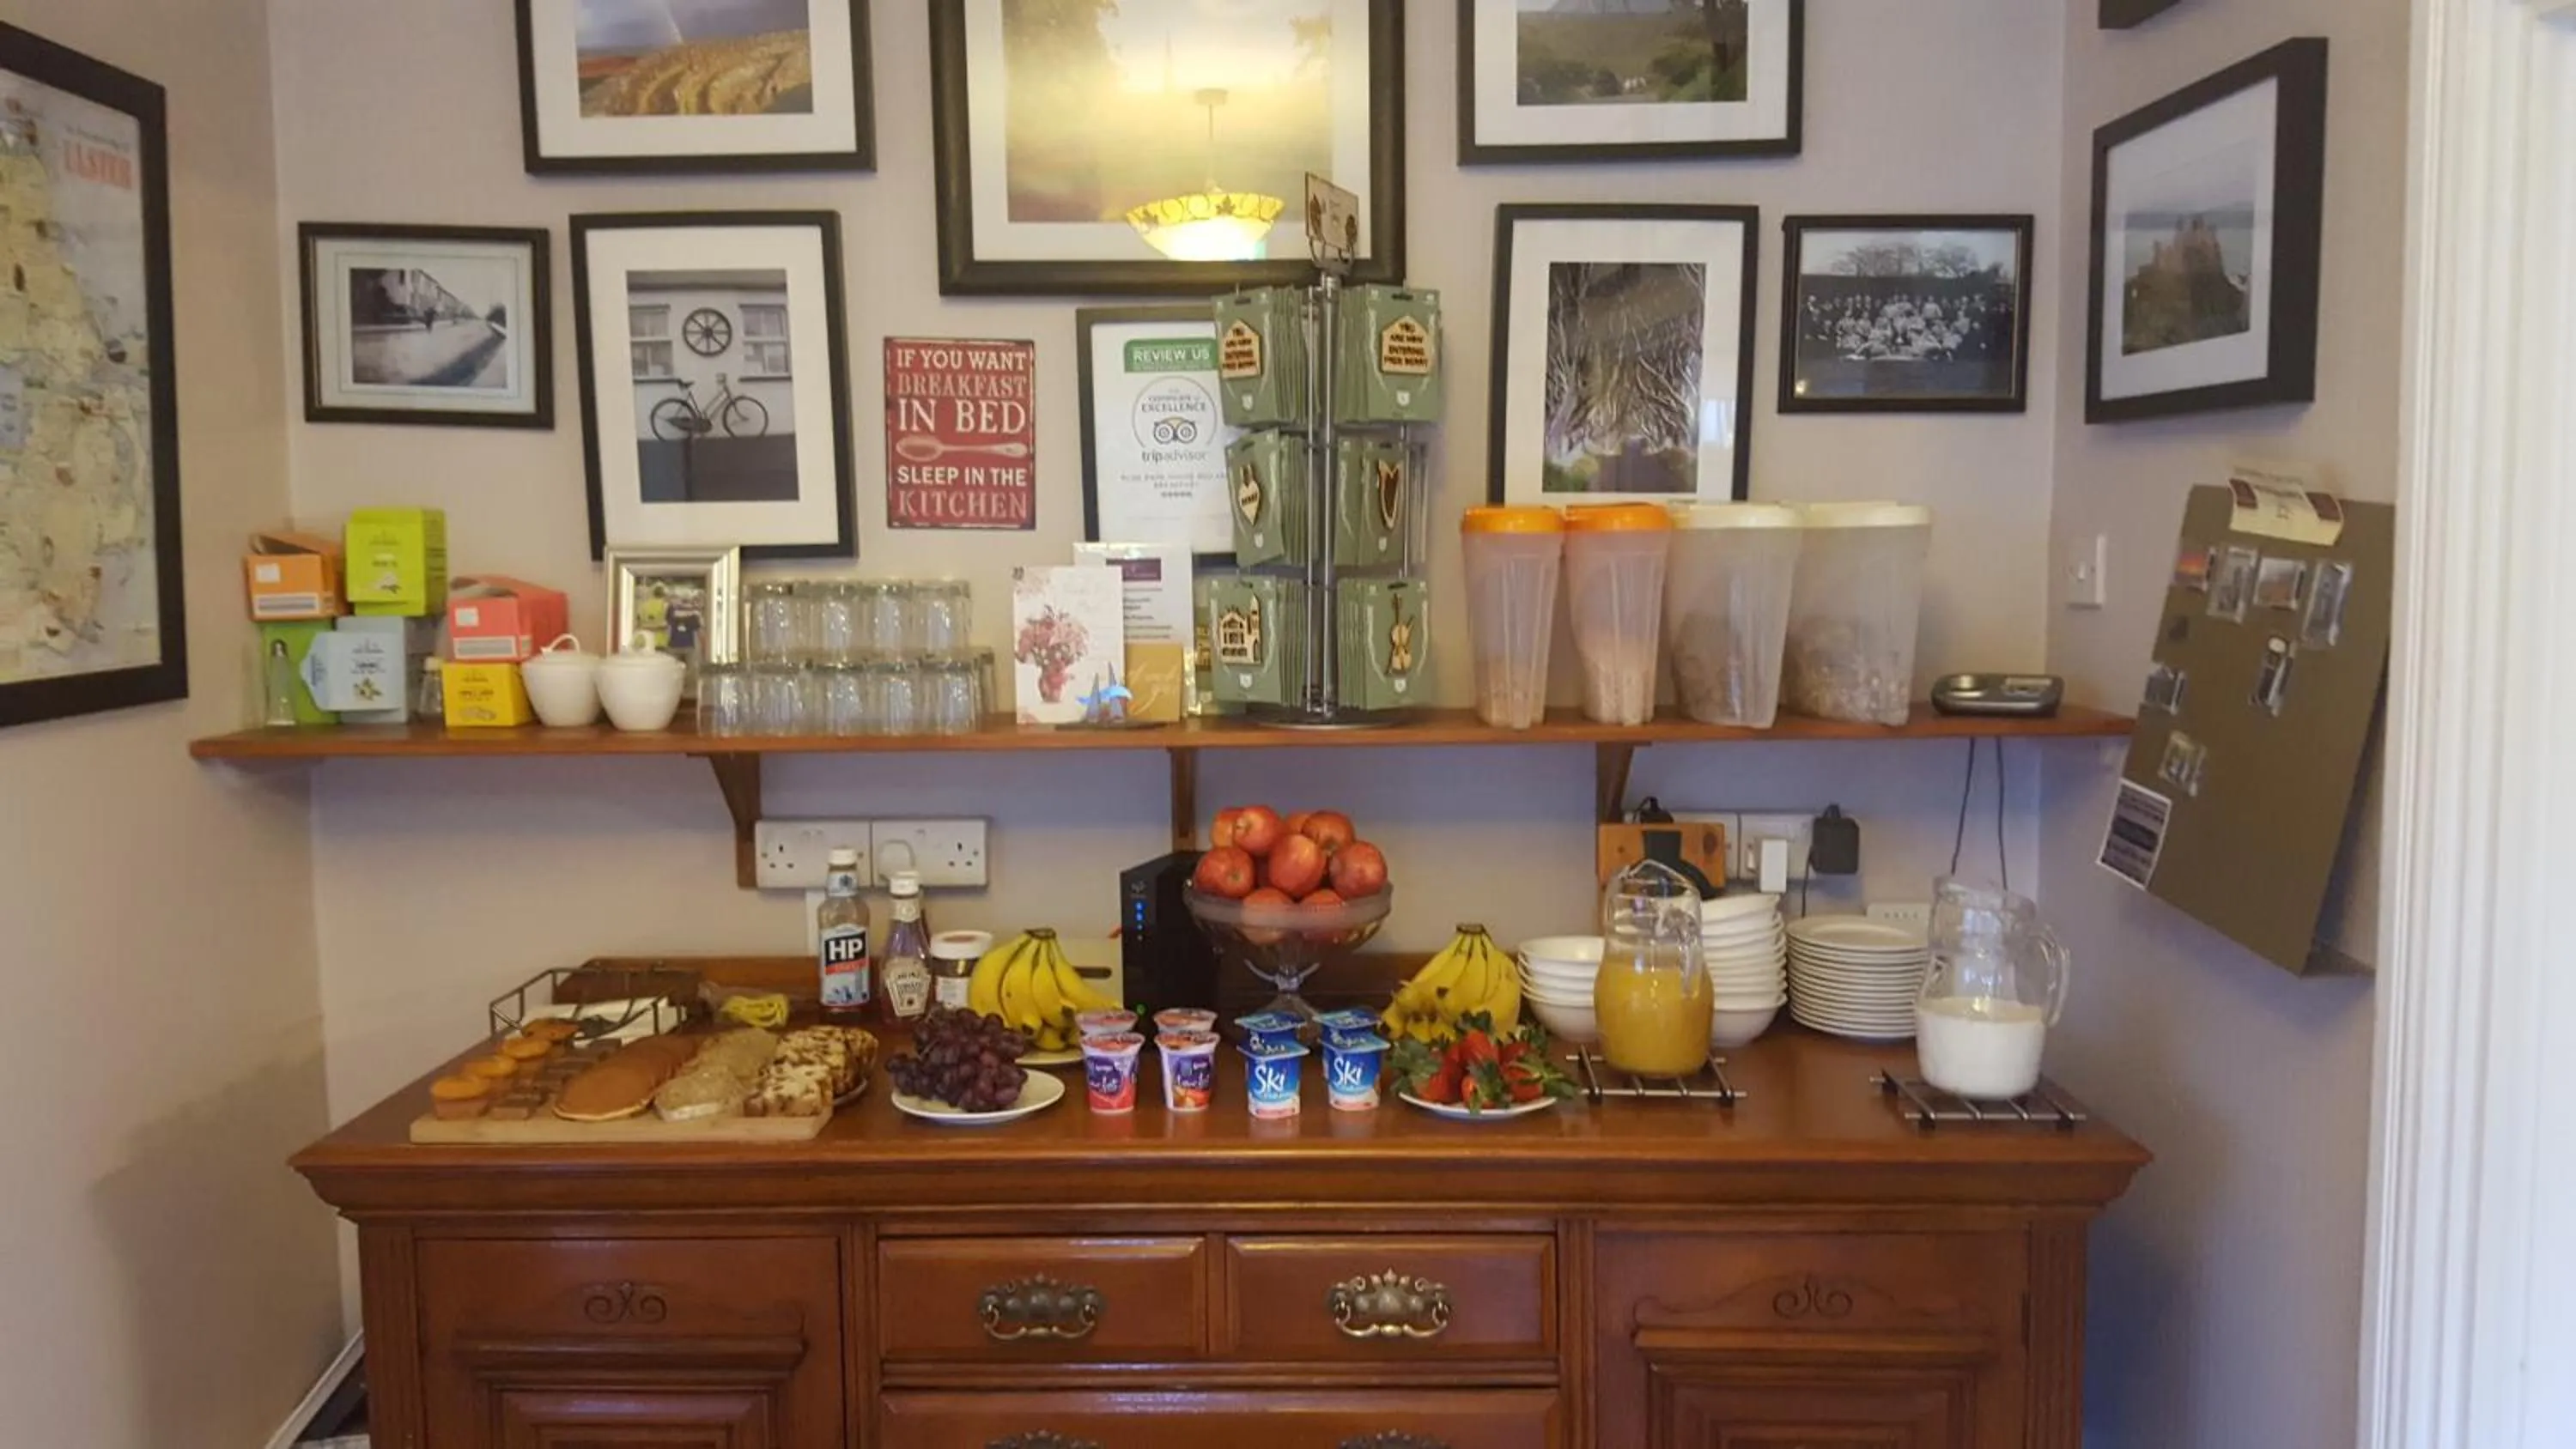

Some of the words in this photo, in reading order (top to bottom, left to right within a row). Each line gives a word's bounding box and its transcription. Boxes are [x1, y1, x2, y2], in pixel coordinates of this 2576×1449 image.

[896, 348, 915, 368] IF
[920, 349, 963, 369] YOU
[968, 350, 1027, 371] WANT
[1133, 348, 1186, 362] REVIEW
[1191, 347, 1211, 361] US
[898, 372, 1027, 398] BREAKFAST
[898, 397, 937, 433] IN
[955, 399, 1026, 433] BED
[1141, 402, 1206, 413] EXCELLENCE
[1141, 448, 1208, 464] tripadvisor
[897, 466, 959, 485] SLEEP
[964, 467, 985, 485] IN
[990, 468, 1027, 487] THE
[899, 490, 1027, 518] KITCHEN
[829, 938, 863, 961] HP
[1254, 1064, 1285, 1095] Ski
[1334, 1057, 1363, 1086] Ski
